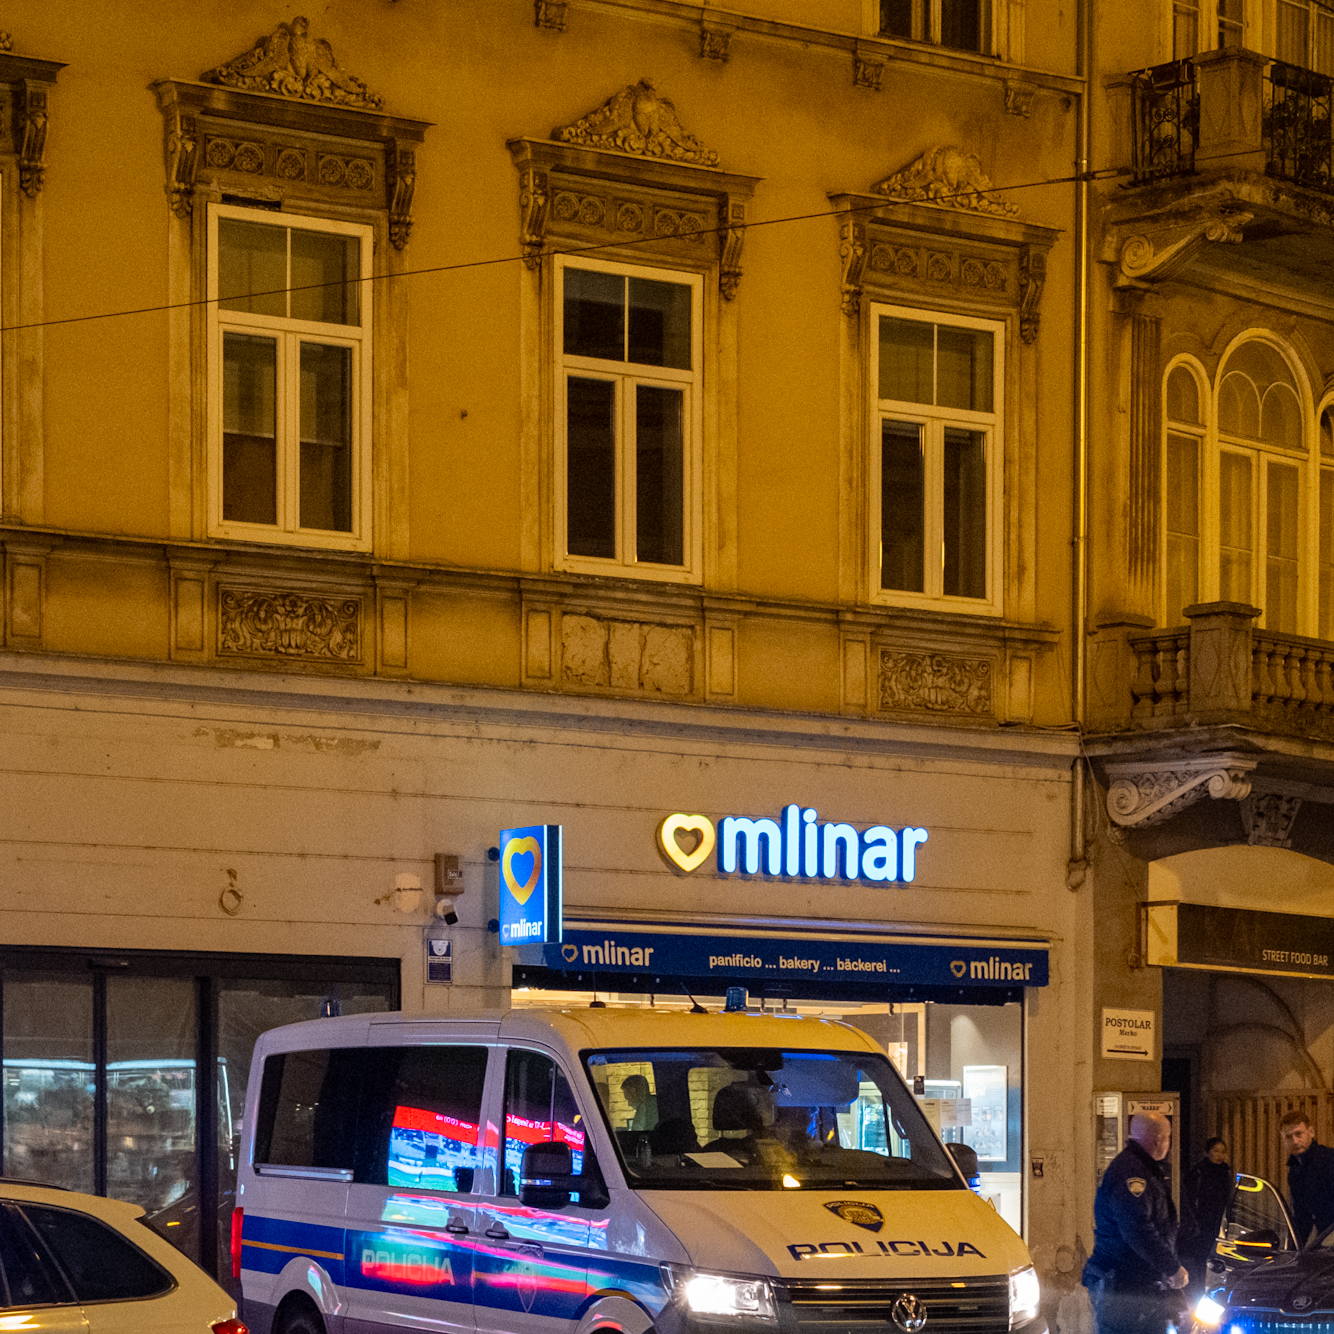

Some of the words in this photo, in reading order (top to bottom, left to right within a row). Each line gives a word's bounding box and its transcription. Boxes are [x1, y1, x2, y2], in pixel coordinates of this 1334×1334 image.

[719, 803, 929, 883] mlinar
[510, 918, 543, 938] mlinar
[582, 940, 654, 967] mlinar
[709, 953, 763, 969] panificio
[779, 955, 820, 973] bakery
[836, 957, 887, 973] bäckerei
[1262, 949, 1289, 962] STREET
[1290, 951, 1312, 965] FOOD
[1313, 954, 1329, 966] BAR
[969, 956, 1033, 980] mlinar
[1105, 1017, 1151, 1029] POSTOLAR
[826, 1201, 875, 1209] POLICIJA
[786, 1240, 987, 1261] POLICIJA
[362, 1249, 455, 1286] POLICIJA
